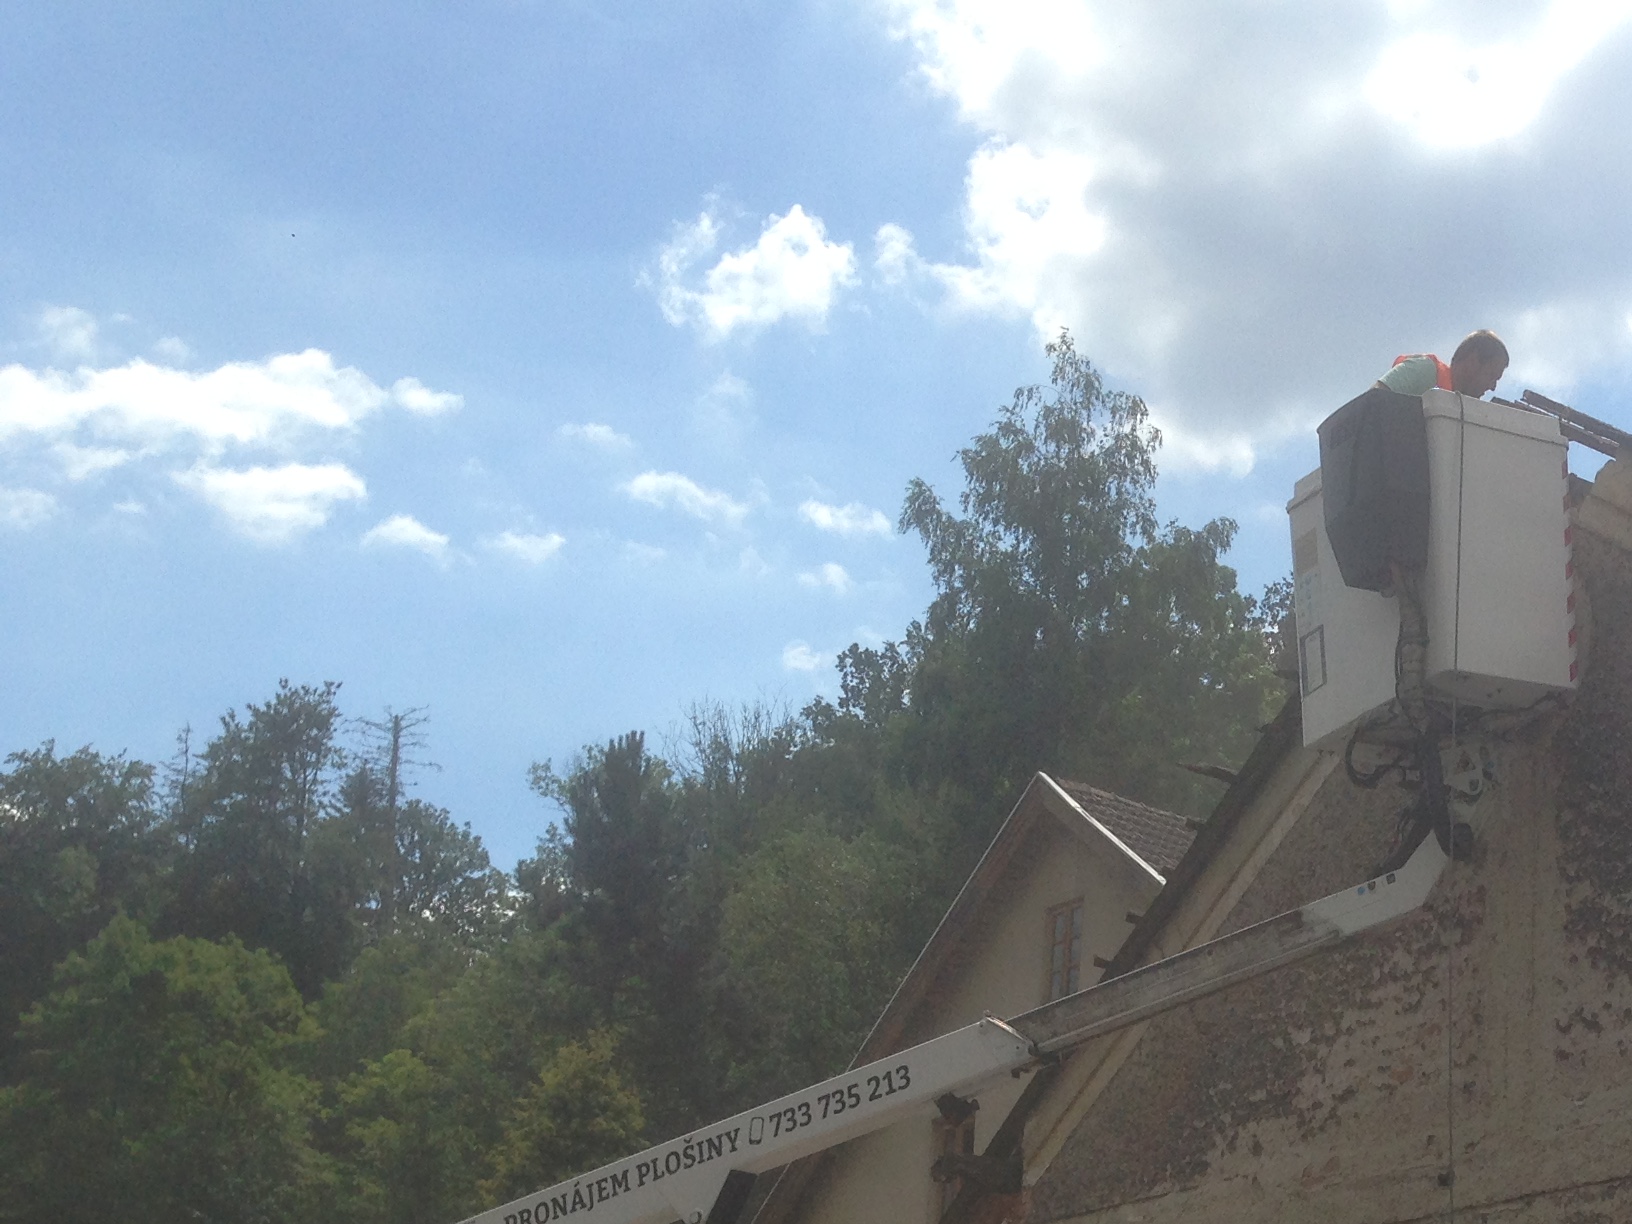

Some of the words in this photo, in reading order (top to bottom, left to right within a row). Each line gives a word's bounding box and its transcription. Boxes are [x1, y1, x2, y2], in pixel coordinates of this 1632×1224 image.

[636, 1127, 741, 1188] PLOŠINY
[768, 1100, 813, 1138] 733
[817, 1083, 861, 1121] 735
[866, 1064, 912, 1103] 213
